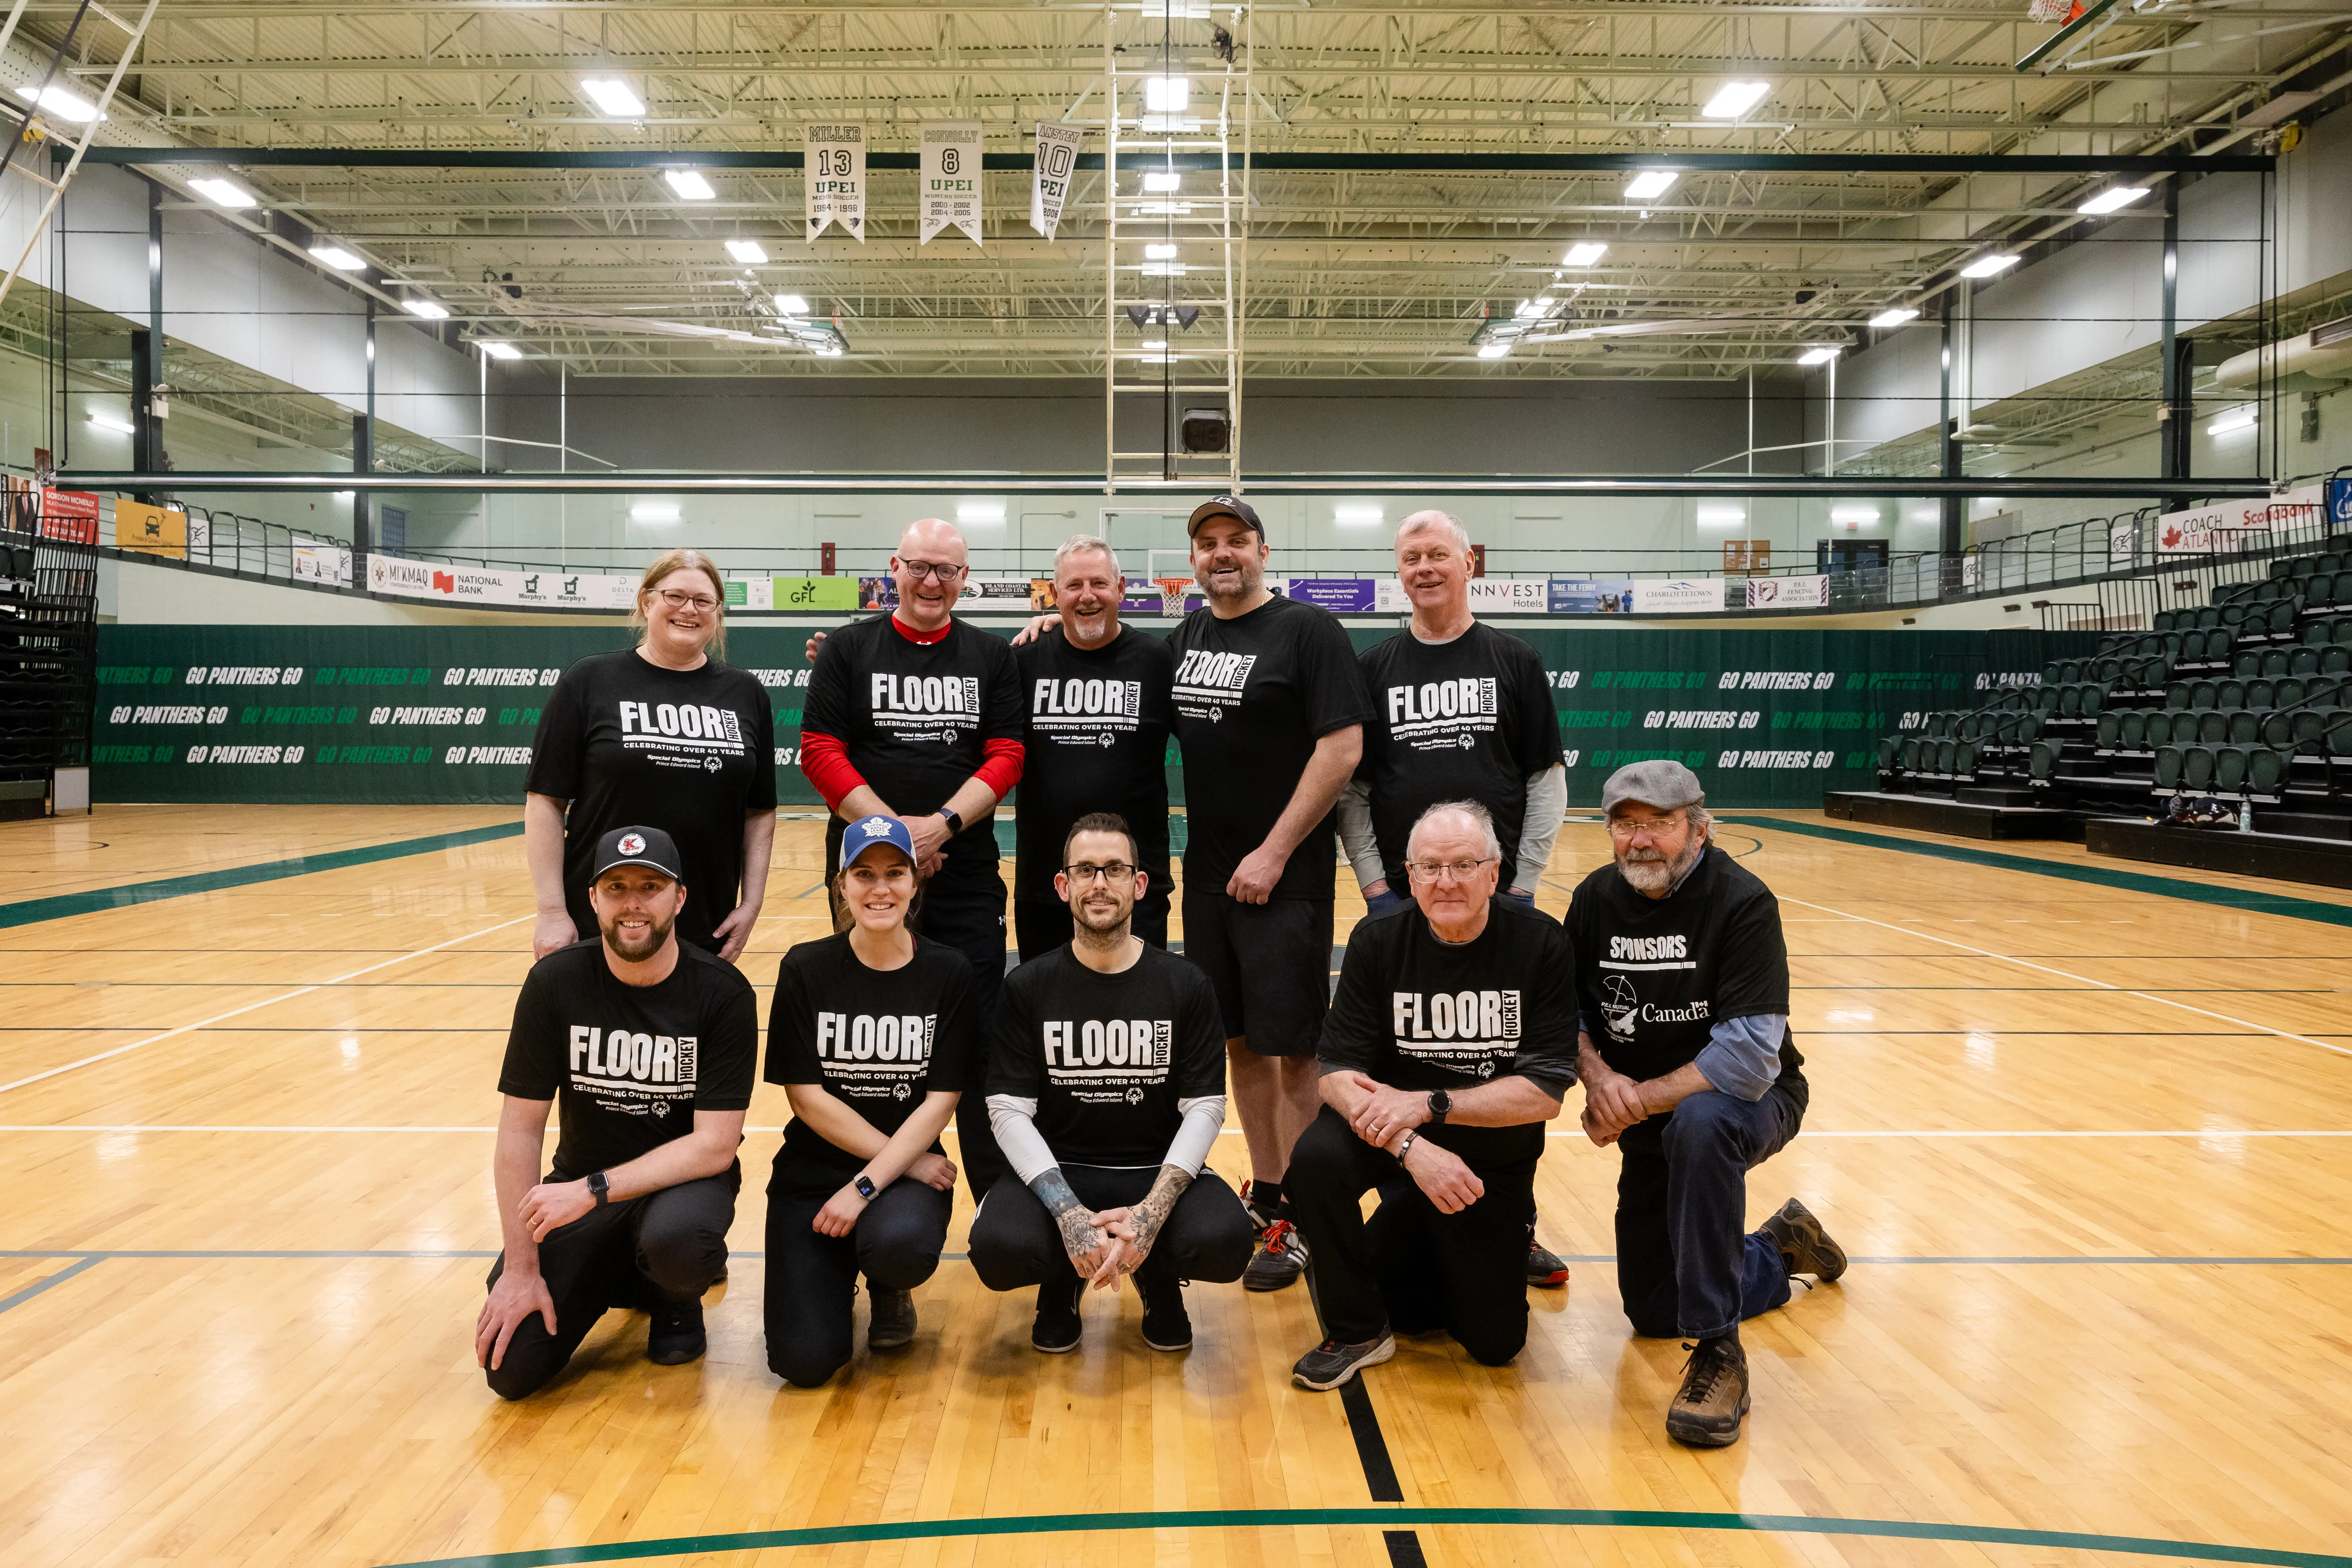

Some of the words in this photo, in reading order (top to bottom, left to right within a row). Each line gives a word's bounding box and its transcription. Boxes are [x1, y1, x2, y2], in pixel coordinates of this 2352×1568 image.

[809, 126, 861, 142] MILLER
[924, 130, 978, 143] CONNOLLY
[1038, 126, 1080, 143] ANSTEY
[819, 150, 851, 176] 13
[942, 148, 959, 174] 8
[1039, 142, 1072, 178] 10
[816, 181, 855, 193] UPEI
[930, 180, 972, 190] UPEI
[1041, 179, 1064, 197] PEI
[814, 204, 831, 212] 1994
[46, 491, 69, 502] GORDON
[2183, 514, 2222, 534] COACH
[458, 575, 503, 586] NATIONAL
[459, 585, 483, 595] BANK
[791, 586, 816, 603] GFL
[1513, 599, 1543, 607] Hotels
[186, 667, 207, 684] GO
[207, 667, 281, 684] PANTHERS
[281, 668, 303, 684] GO
[338, 668, 410, 685] PANTHERS
[444, 668, 465, 685] GO
[466, 668, 538, 686] PANTHERS
[540, 669, 561, 686] GO
[1175, 649, 1243, 687] FLOOR
[1232, 656, 1253, 687] HOCKEY
[1718, 672, 1741, 689] GO
[1740, 672, 1812, 690] PANTHERS
[1813, 672, 1834, 690] GO
[872, 673, 964, 712] FLOOR
[964, 679, 977, 712] HOCKEY
[1033, 678, 1124, 714] FLOOR
[1126, 683, 1139, 715] HOCKEY
[1388, 678, 1479, 724] FLOOR
[1482, 680, 1494, 712] HOCKEY
[110, 706, 131, 723] GO
[132, 707, 206, 723] PANTHERS
[207, 707, 228, 723] GO
[369, 707, 391, 725] GO
[391, 707, 464, 725] PANTHERS
[464, 707, 486, 725] GO
[619, 701, 725, 739] FLOOR
[1644, 711, 1666, 728] GO
[1665, 711, 1738, 728] PANTHERS
[1738, 711, 1760, 729] GO
[722, 711, 740, 740] HOCKEY
[1394, 728, 1439, 741] CELEBRATING
[624, 743, 681, 752] CELEBRATING
[1610, 935, 1686, 960] SPONSORS
[1393, 991, 1502, 1039] FLOOR
[1503, 992, 1518, 1036] HOCKEY
[1642, 1002, 1711, 1022] Canada
[817, 1012, 924, 1060] FLOOR
[1043, 1020, 1153, 1066] FLOOR
[1155, 1022, 1169, 1064] HOCKEY
[570, 1025, 676, 1082] FLOOR
[680, 1039, 694, 1080] HOCKEY
[824, 1070, 871, 1080] ELEBRATING
[1051, 1077, 1103, 1086] CELEBRATING
[573, 1084, 626, 1097] CELEBRATING
